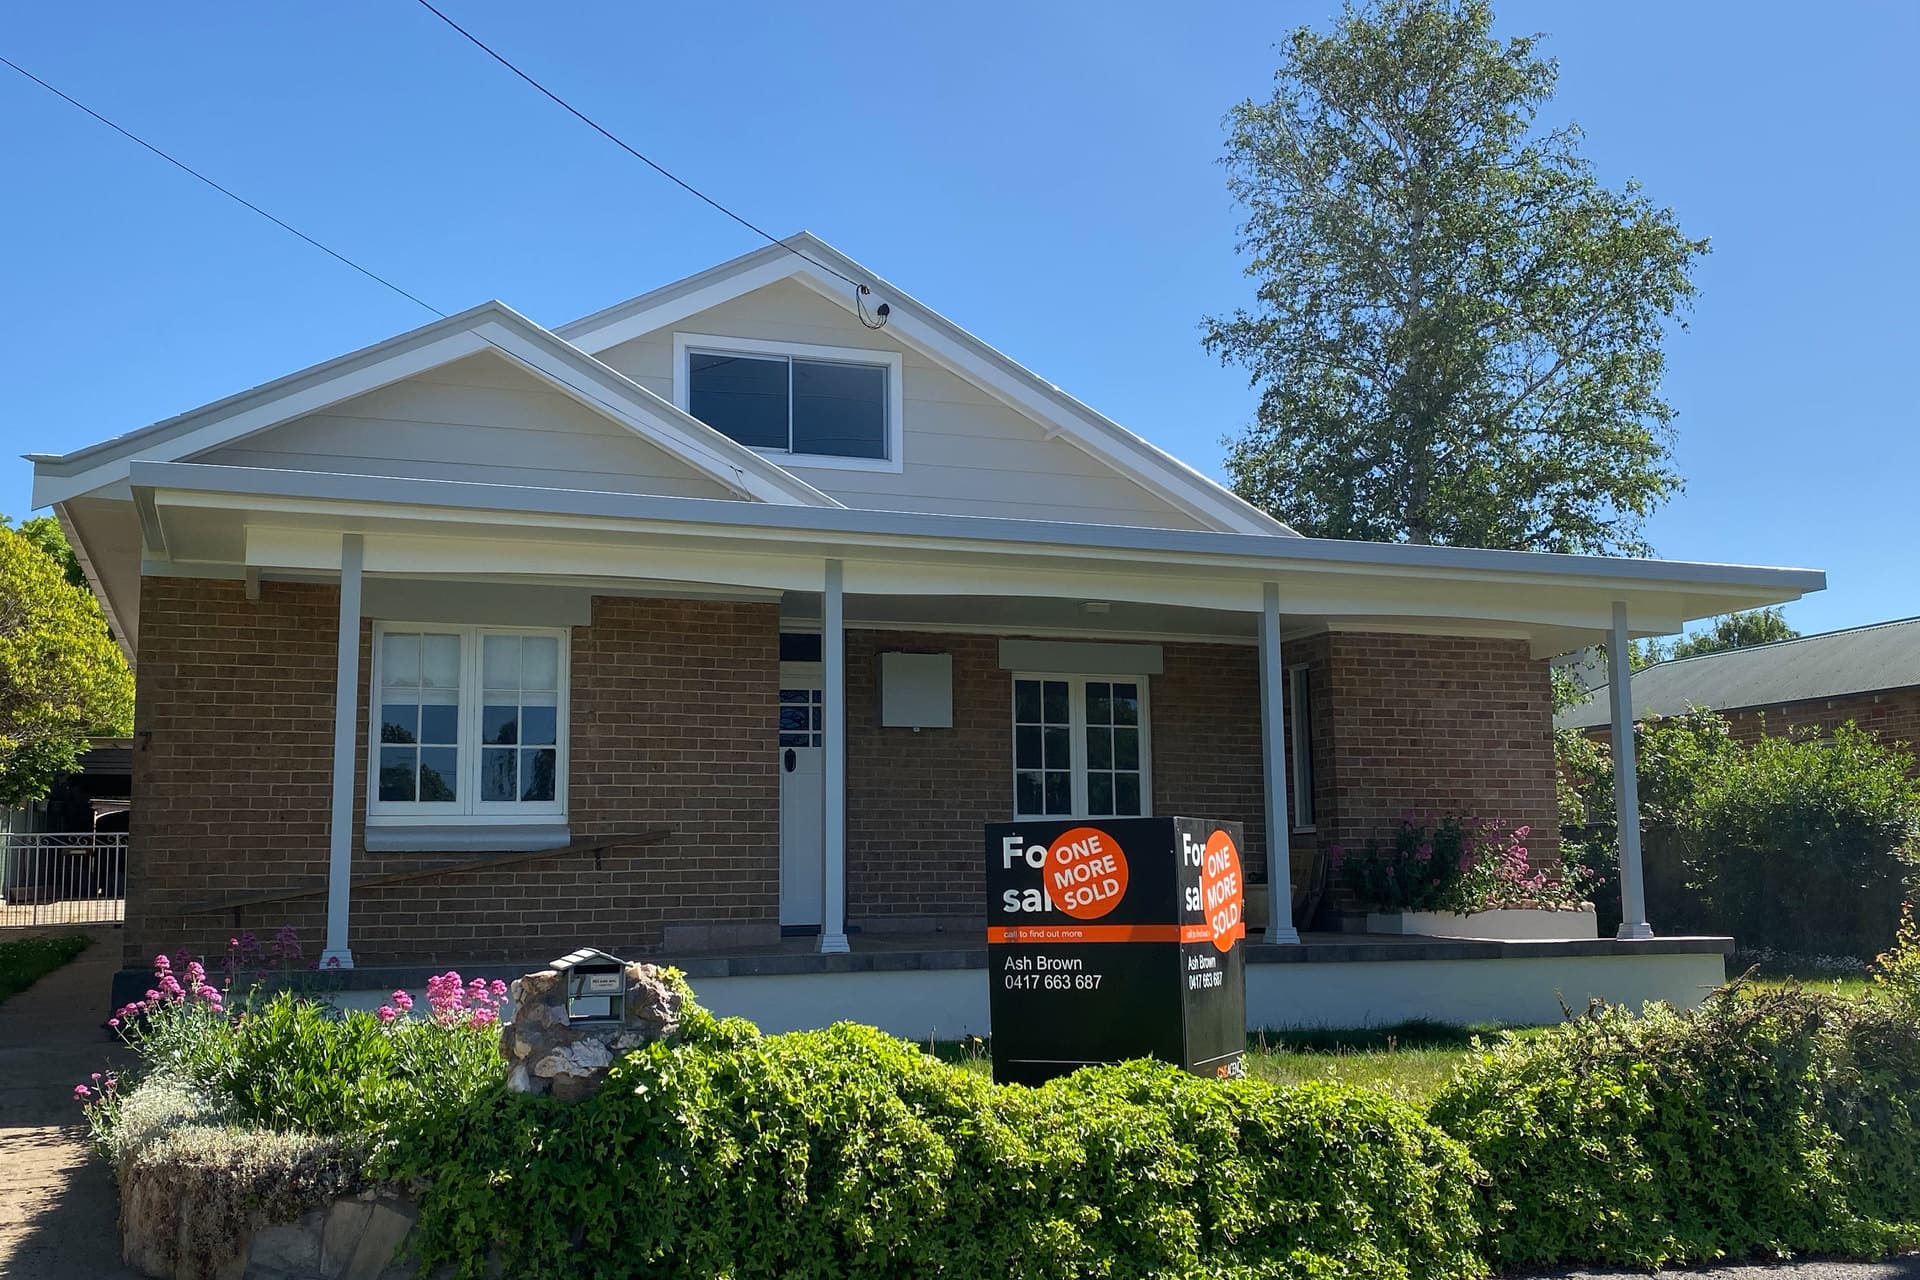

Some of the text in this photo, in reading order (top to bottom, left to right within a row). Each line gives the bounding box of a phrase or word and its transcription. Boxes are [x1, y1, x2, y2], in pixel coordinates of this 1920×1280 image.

[1002, 836, 1048, 869] Fo
[1055, 835, 1103, 865] ONE
[1207, 845, 1231, 878] ONE
[1053, 854, 1118, 890] MORE
[1002, 882, 1054, 912] sal
[1064, 878, 1120, 911] SOLD
[1185, 875, 1203, 911] sal
[1207, 871, 1237, 912] MORE
[1003, 930, 1083, 938] call to find out more
[1212, 903, 1238, 939] SOLD
[1004, 955, 1082, 970] Ash Brown
[1187, 954, 1217, 971] Ash Brown
[1004, 974, 1102, 989] 0417 663 687
[1188, 971, 1223, 990] 0417 663 687
